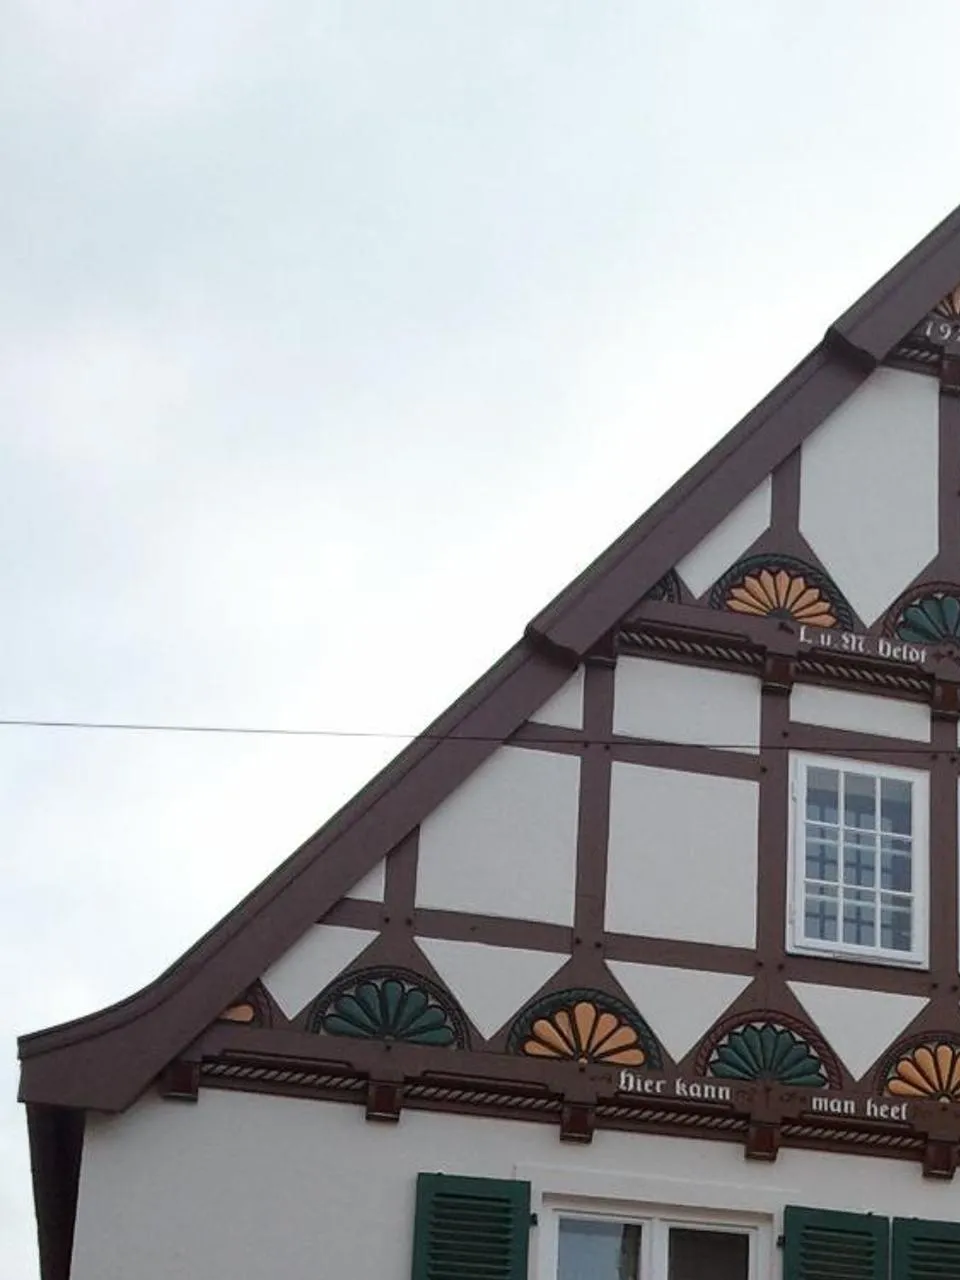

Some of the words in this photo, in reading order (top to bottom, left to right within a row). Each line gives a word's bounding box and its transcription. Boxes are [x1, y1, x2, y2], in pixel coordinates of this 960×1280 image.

[616, 1068, 666, 1094] Hier
[675, 1077, 732, 1101] kann
[811, 1096, 856, 1116] man
